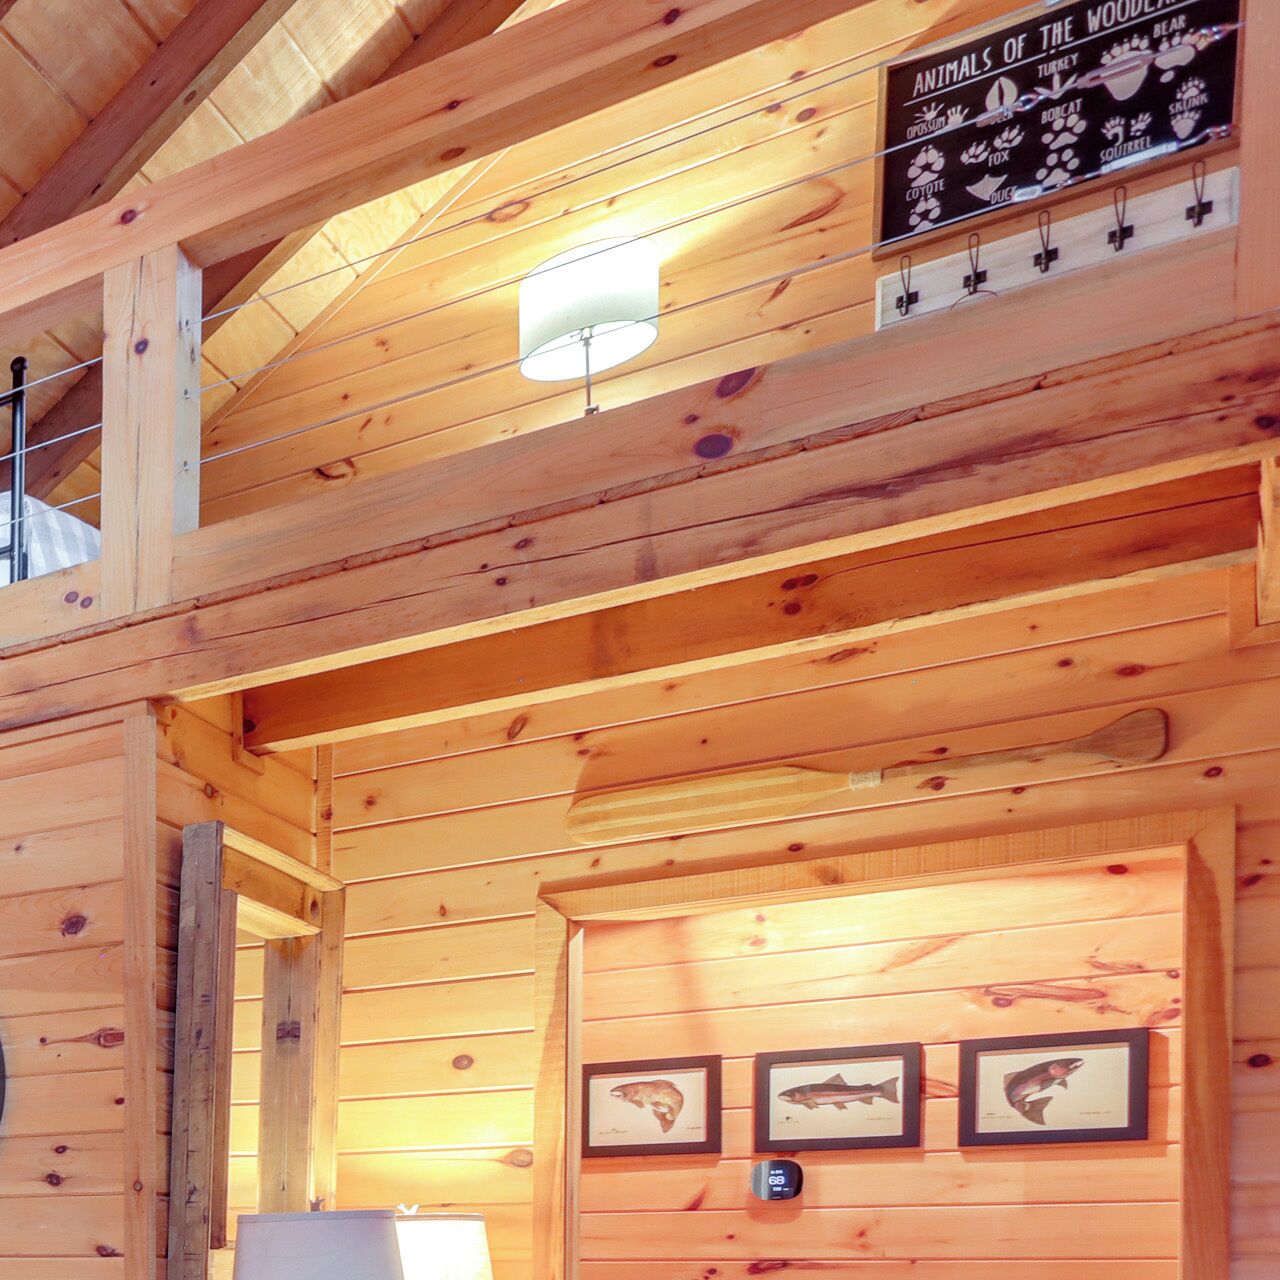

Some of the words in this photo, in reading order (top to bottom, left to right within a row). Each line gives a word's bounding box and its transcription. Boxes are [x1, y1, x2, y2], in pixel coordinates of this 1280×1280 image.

[1152, 14, 1187, 39] BEAR
[912, 47, 992, 98] ANIMALS
[1003, 33, 1027, 64] OF
[1039, 16, 1075, 51] THE
[1037, 52, 1079, 79] TURKEY
[1040, 98, 1083, 125] BOBCAT
[1168, 92, 1209, 115] SKUNK
[906, 115, 946, 140] OPOSSUM
[988, 149, 1010, 168] FOX
[1099, 135, 1153, 164] SQUIRREL
[905, 177, 946, 202] COYOTE
[768, 1175, 785, 1185] 68
